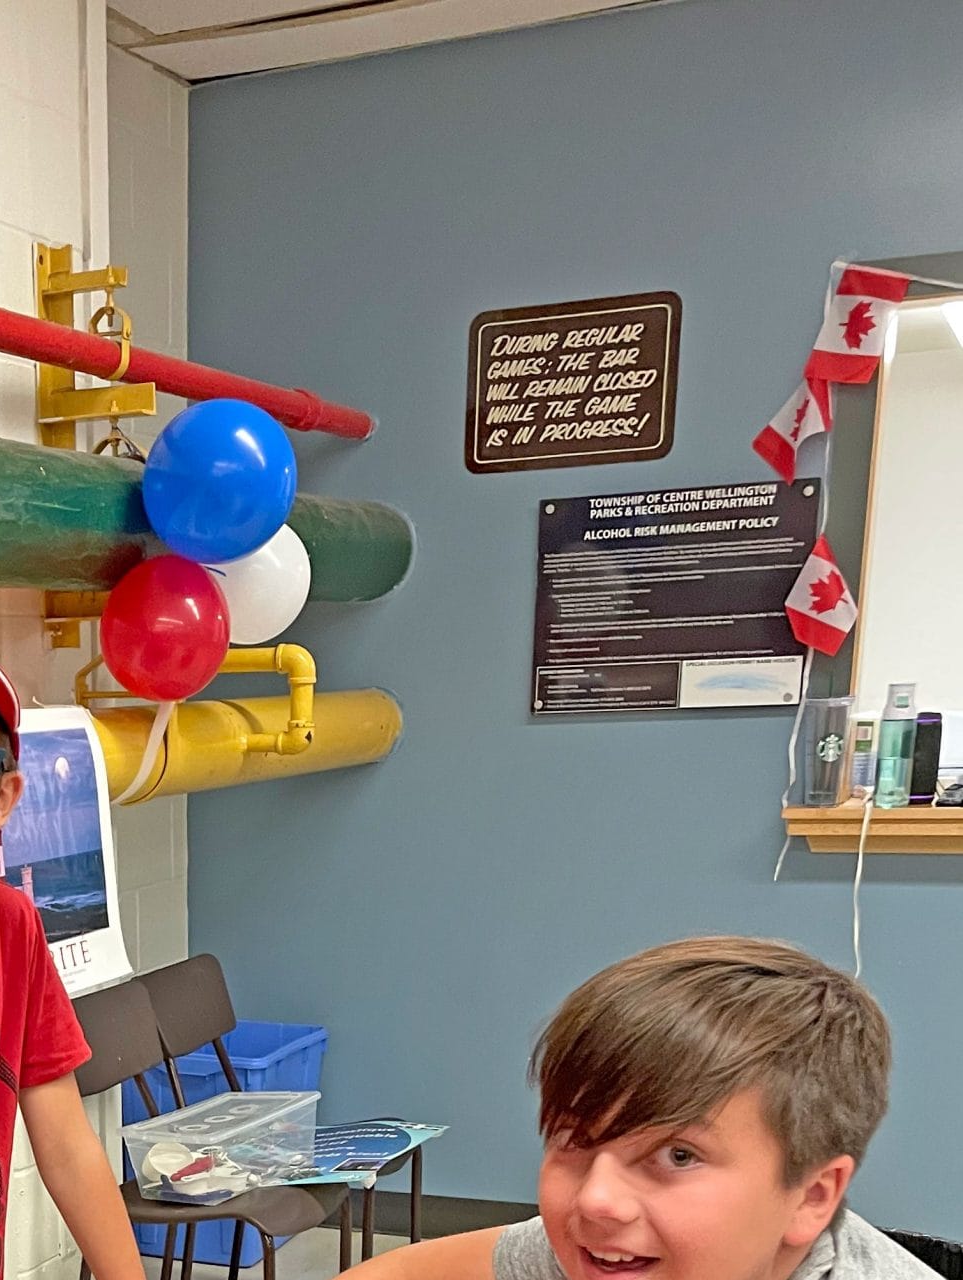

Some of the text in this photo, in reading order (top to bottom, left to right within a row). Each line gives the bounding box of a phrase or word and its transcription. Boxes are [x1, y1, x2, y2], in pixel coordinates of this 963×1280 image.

[490, 323, 644, 357] DURING REGULAR
[556, 352, 596, 373] THE
[598, 347, 640, 368] BAR
[486, 369, 658, 402] WILL REMAIN CLOSED
[486, 393, 641, 425] WHILE THE GAME
[486, 412, 651, 448] IS IN PROGRESS!
[588, 483, 777, 509] TOWNSHIP OF CENTRE WELLINGTON
[589, 495, 775, 520] PARKS & RECREATION DEPARTMENT
[583, 516, 780, 541] ALCOHOL RISK MANAGEMENT POLICY
